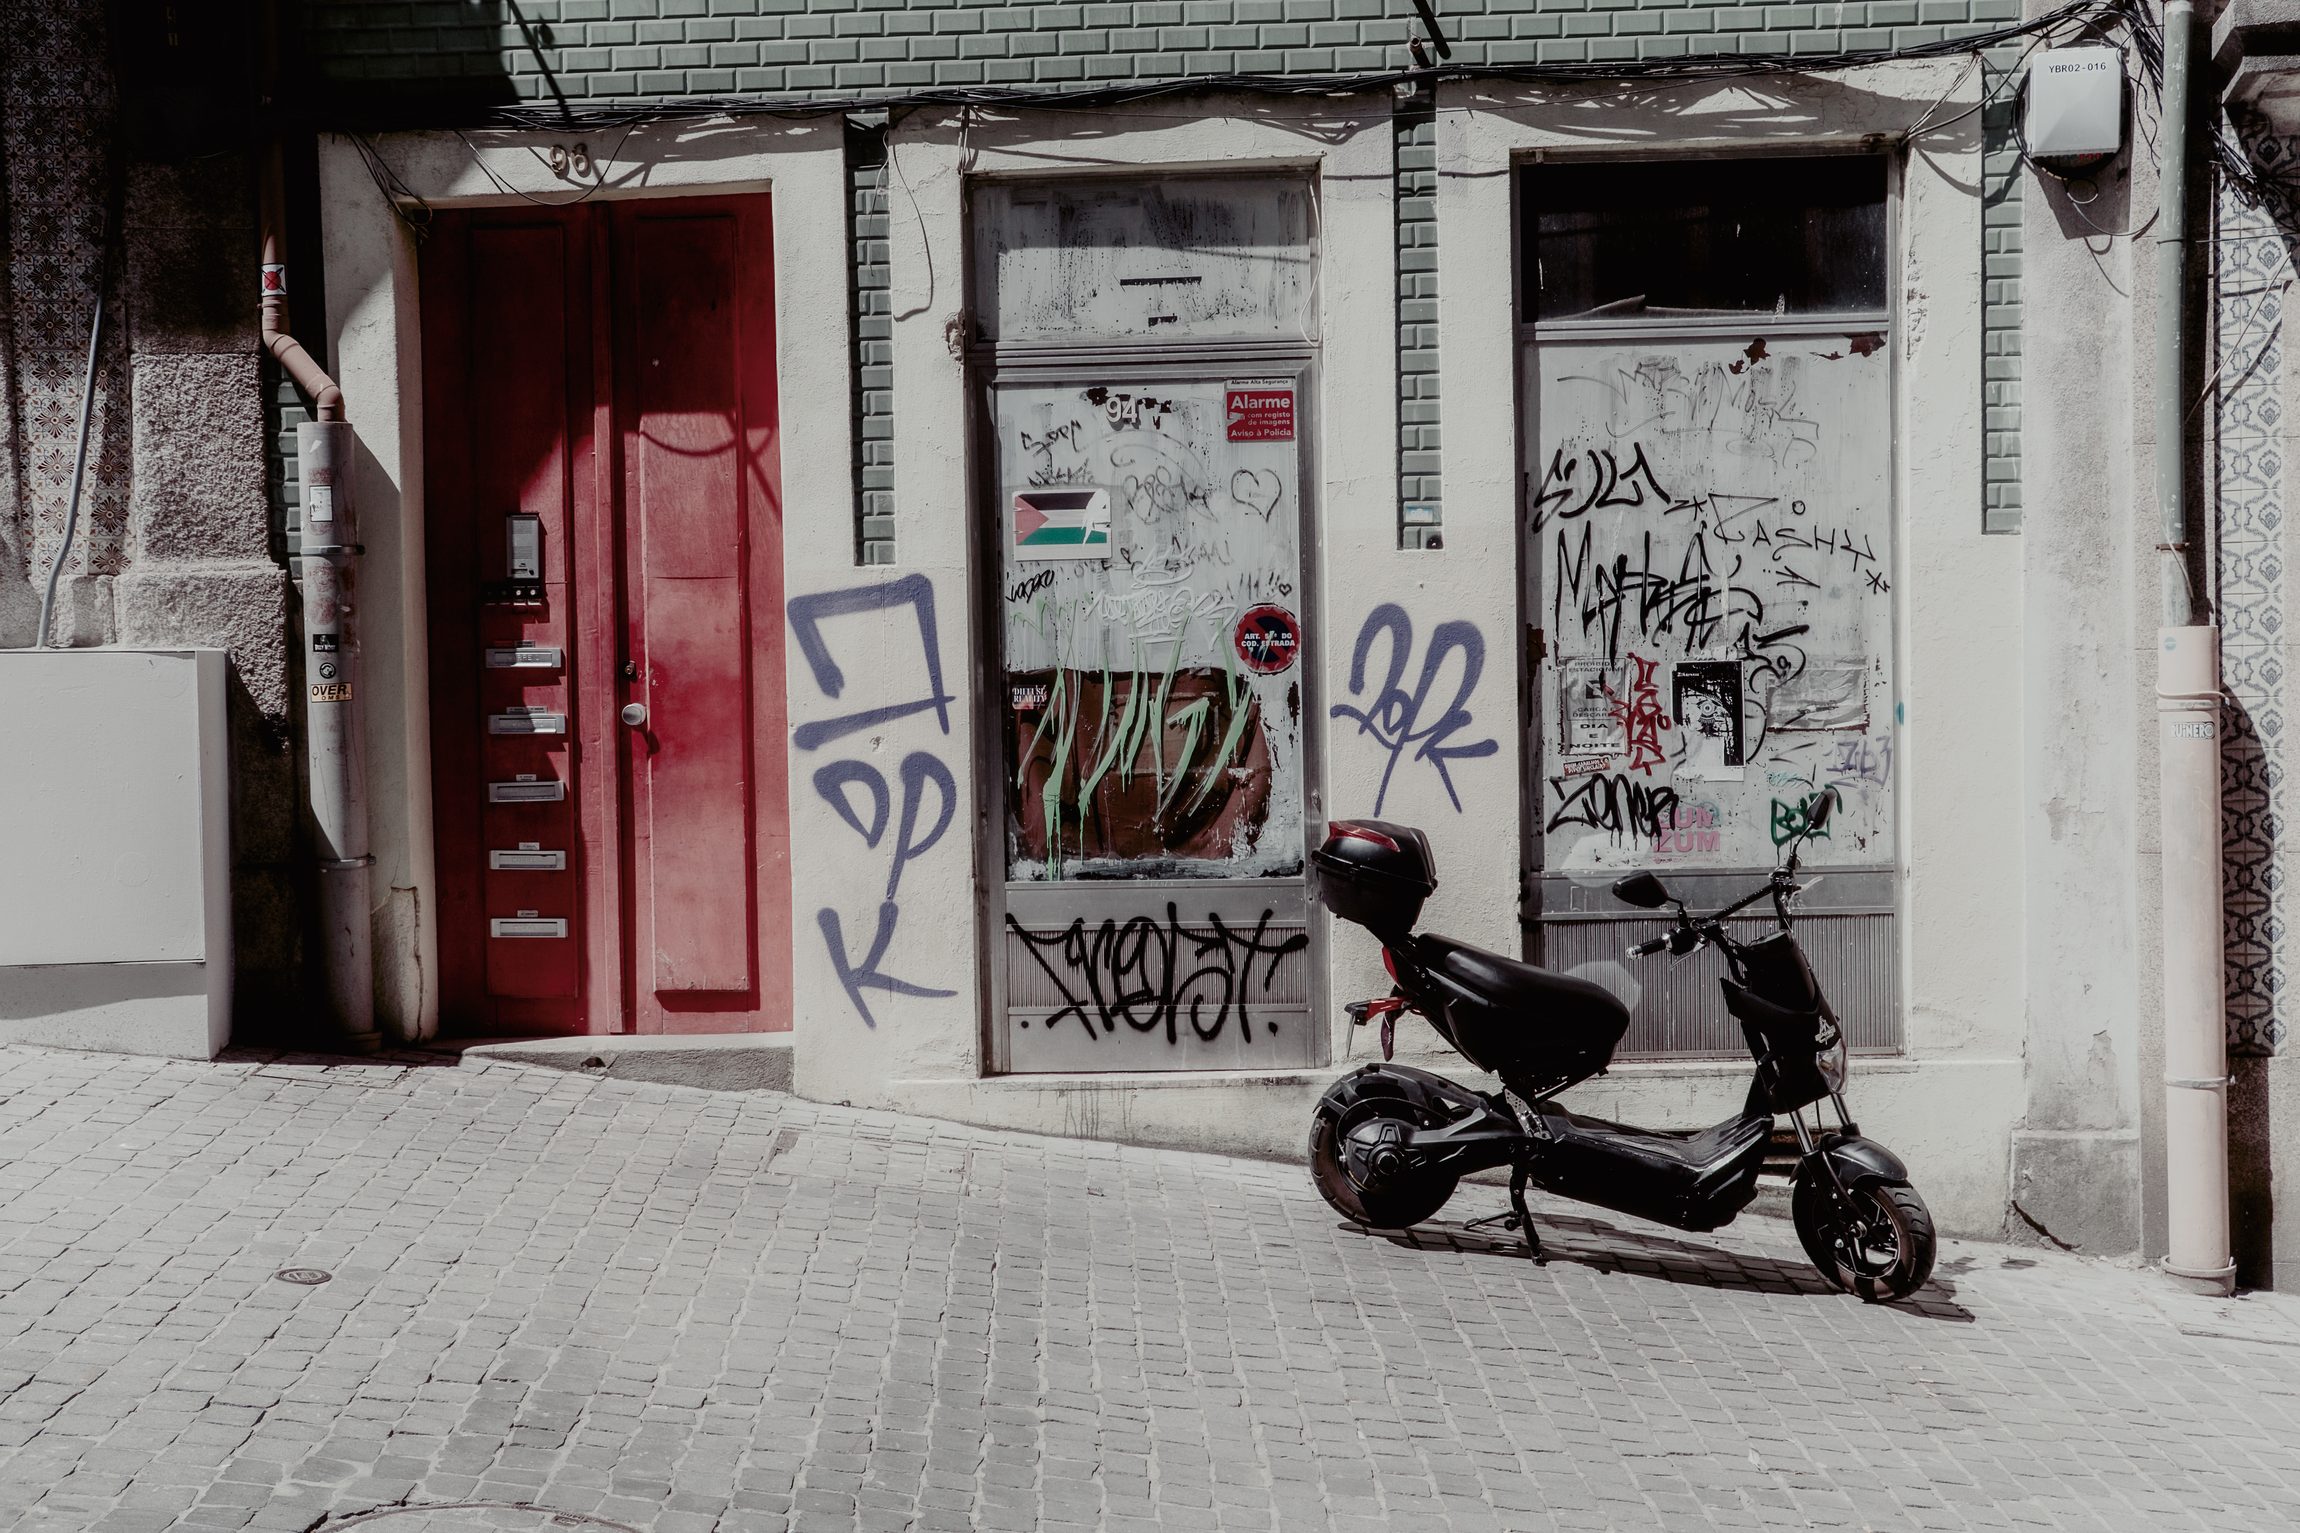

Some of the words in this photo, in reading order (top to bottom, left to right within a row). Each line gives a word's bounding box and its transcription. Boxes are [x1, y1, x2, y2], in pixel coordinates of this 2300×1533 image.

[2049, 62, 2107, 73] YBR02-016
[1231, 394, 1291, 409] Alarme
[1106, 396, 1137, 423] 94
[1264, 411, 1291, 420] registo
[1259, 419, 1291, 427] imagens
[1231, 428, 1254, 437] Aviso
[312, 686, 347, 696] OVER
[1653, 831, 1721, 853] ZUM
